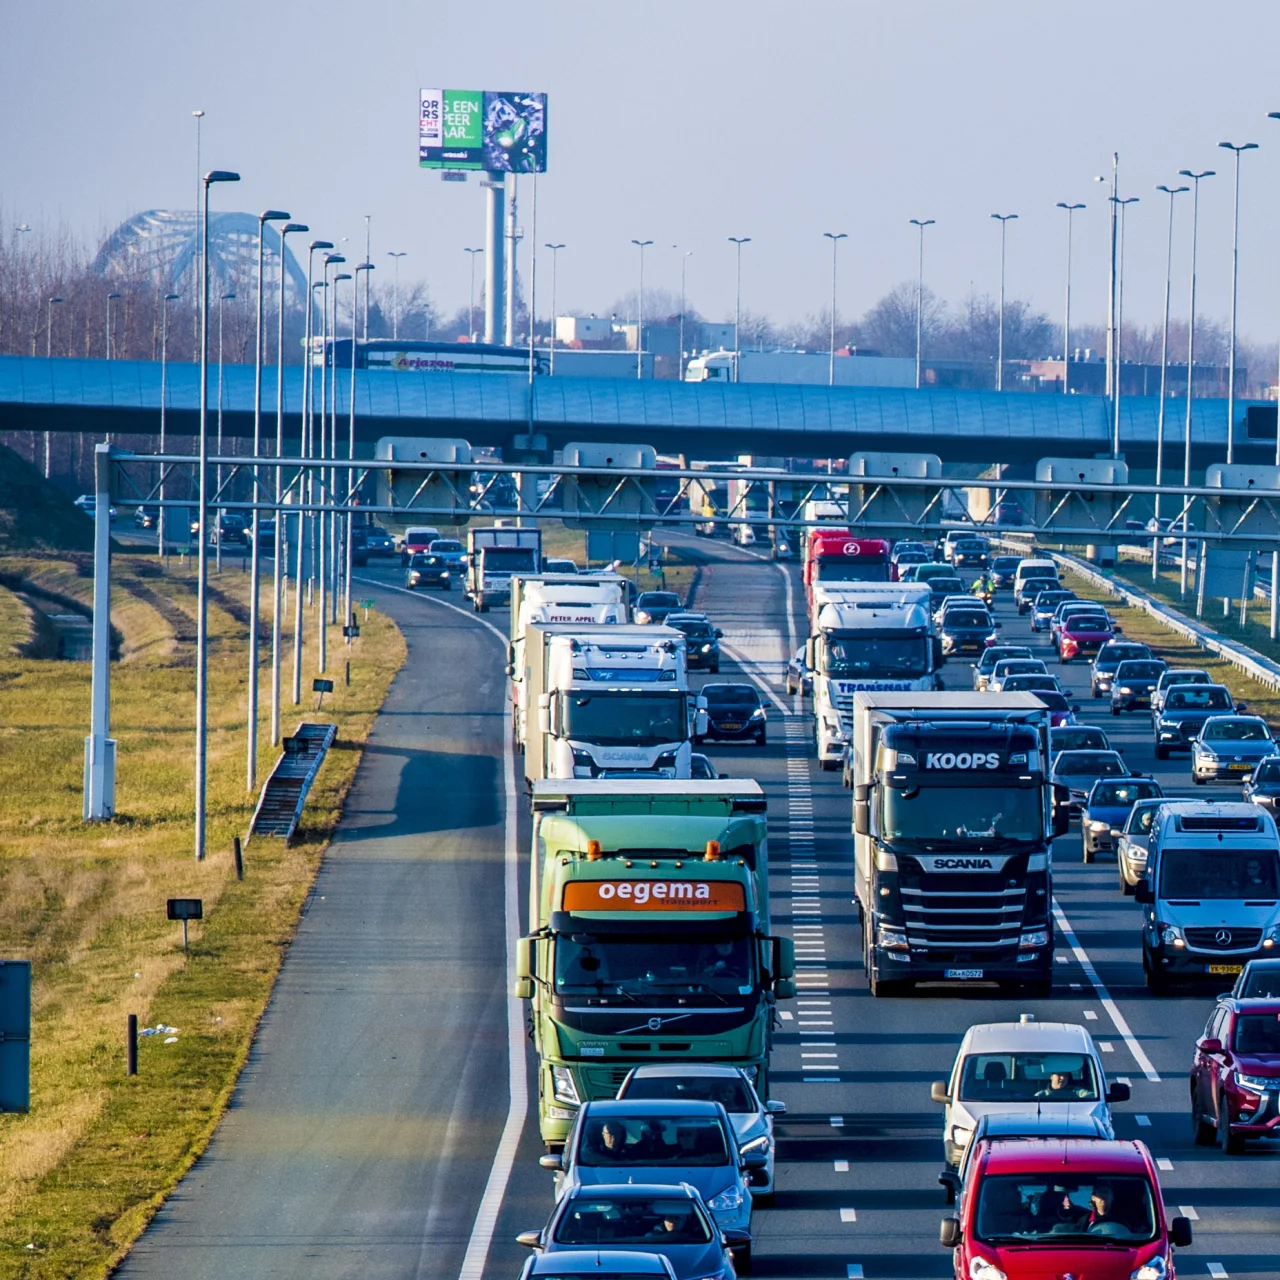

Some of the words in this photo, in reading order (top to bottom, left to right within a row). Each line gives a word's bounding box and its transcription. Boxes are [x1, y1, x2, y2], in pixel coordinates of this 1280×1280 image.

[453, 101, 478, 113] EEN
[926, 753, 1000, 769] KOOPS
[933, 858, 993, 869] SCANIA
[598, 882, 710, 904] oegema
